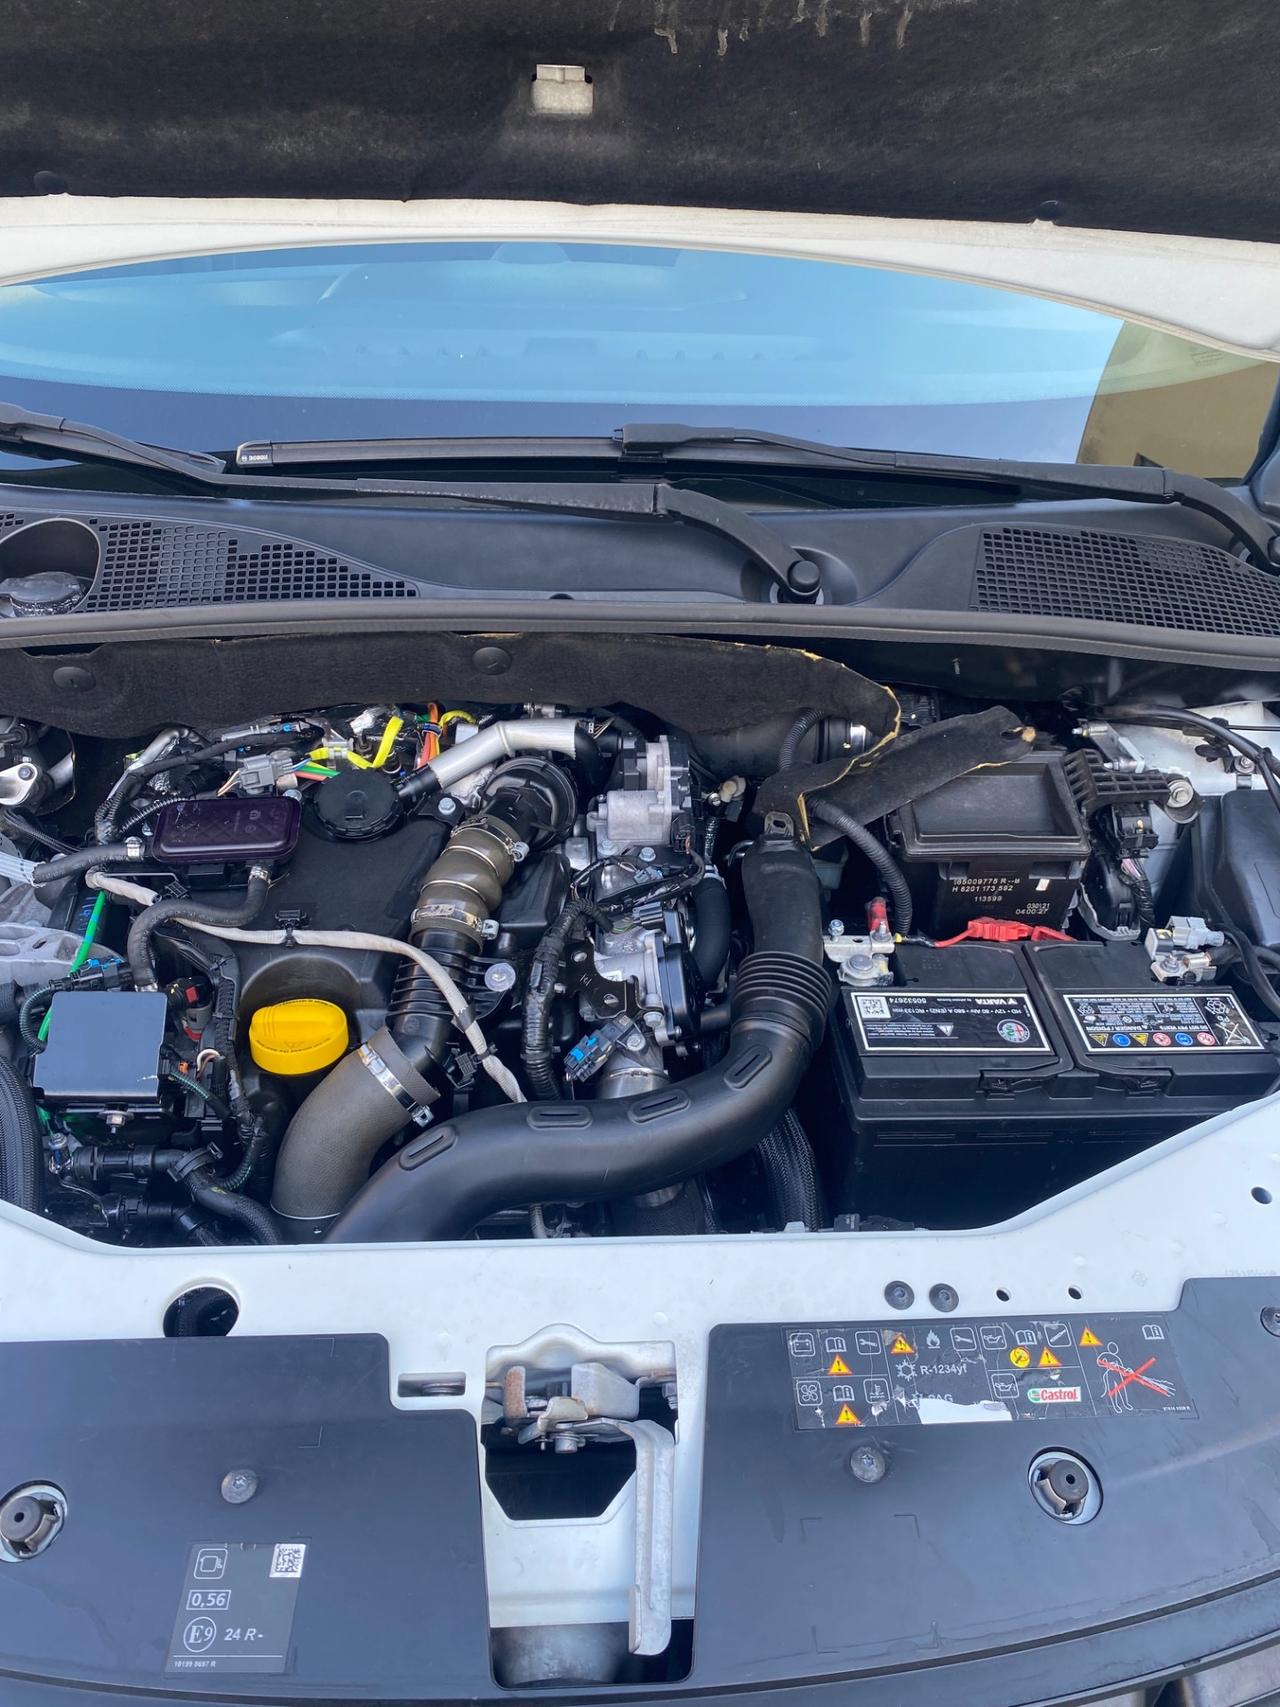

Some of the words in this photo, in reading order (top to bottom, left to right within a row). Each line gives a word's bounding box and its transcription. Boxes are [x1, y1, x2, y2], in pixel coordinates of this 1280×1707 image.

[919, 1363, 967, 1377] R-1234yf
[1040, 1387, 1077, 1400] Castrol
[191, 1592, 227, 1608] 0,56
[223, 1627, 241, 1641] 24
